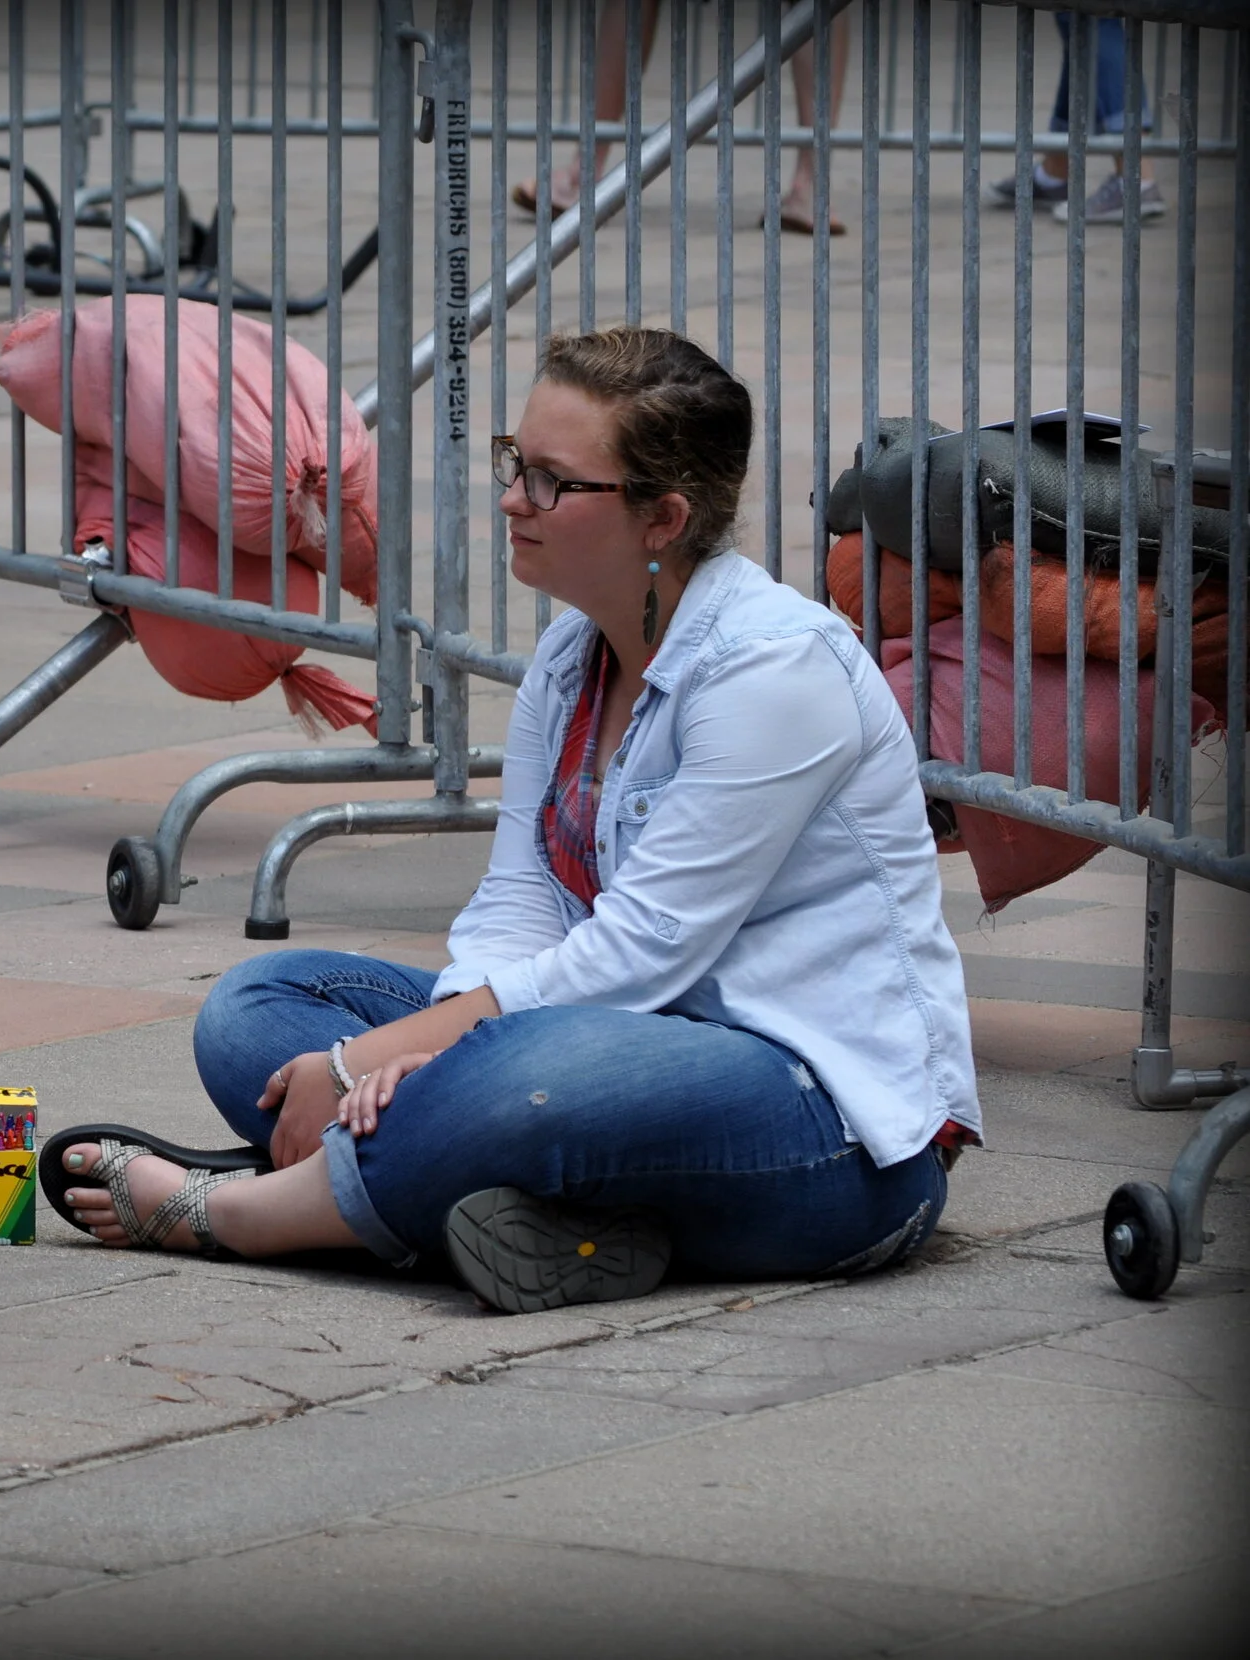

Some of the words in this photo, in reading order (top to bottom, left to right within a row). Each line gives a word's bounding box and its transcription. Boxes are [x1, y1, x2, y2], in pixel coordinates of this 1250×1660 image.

[447, 100, 467, 237] FRIEDRICHS
[448, 247, 470, 310] (800)
[449, 315, 468, 442] 394-9294
